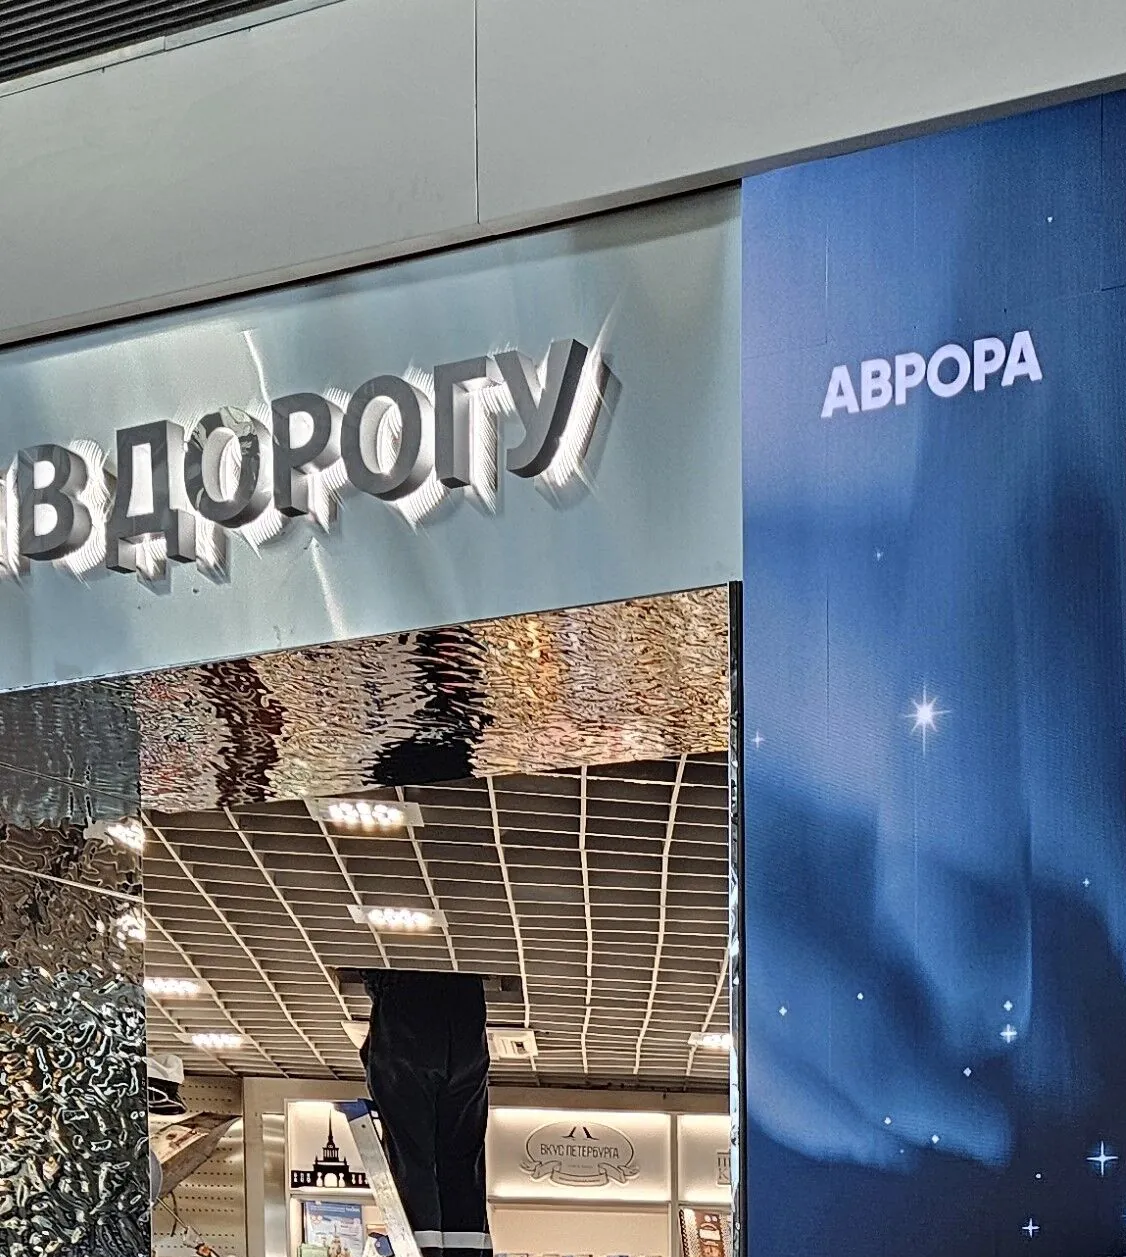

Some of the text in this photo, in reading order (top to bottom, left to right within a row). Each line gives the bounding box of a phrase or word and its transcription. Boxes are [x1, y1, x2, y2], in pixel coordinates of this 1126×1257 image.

[820, 330, 1044, 419] АВРОРА
[106, 338, 589, 575] ДОРОГУ
[540, 1143, 620, 1159] ВКУС ПЕТЕРБУРГА
